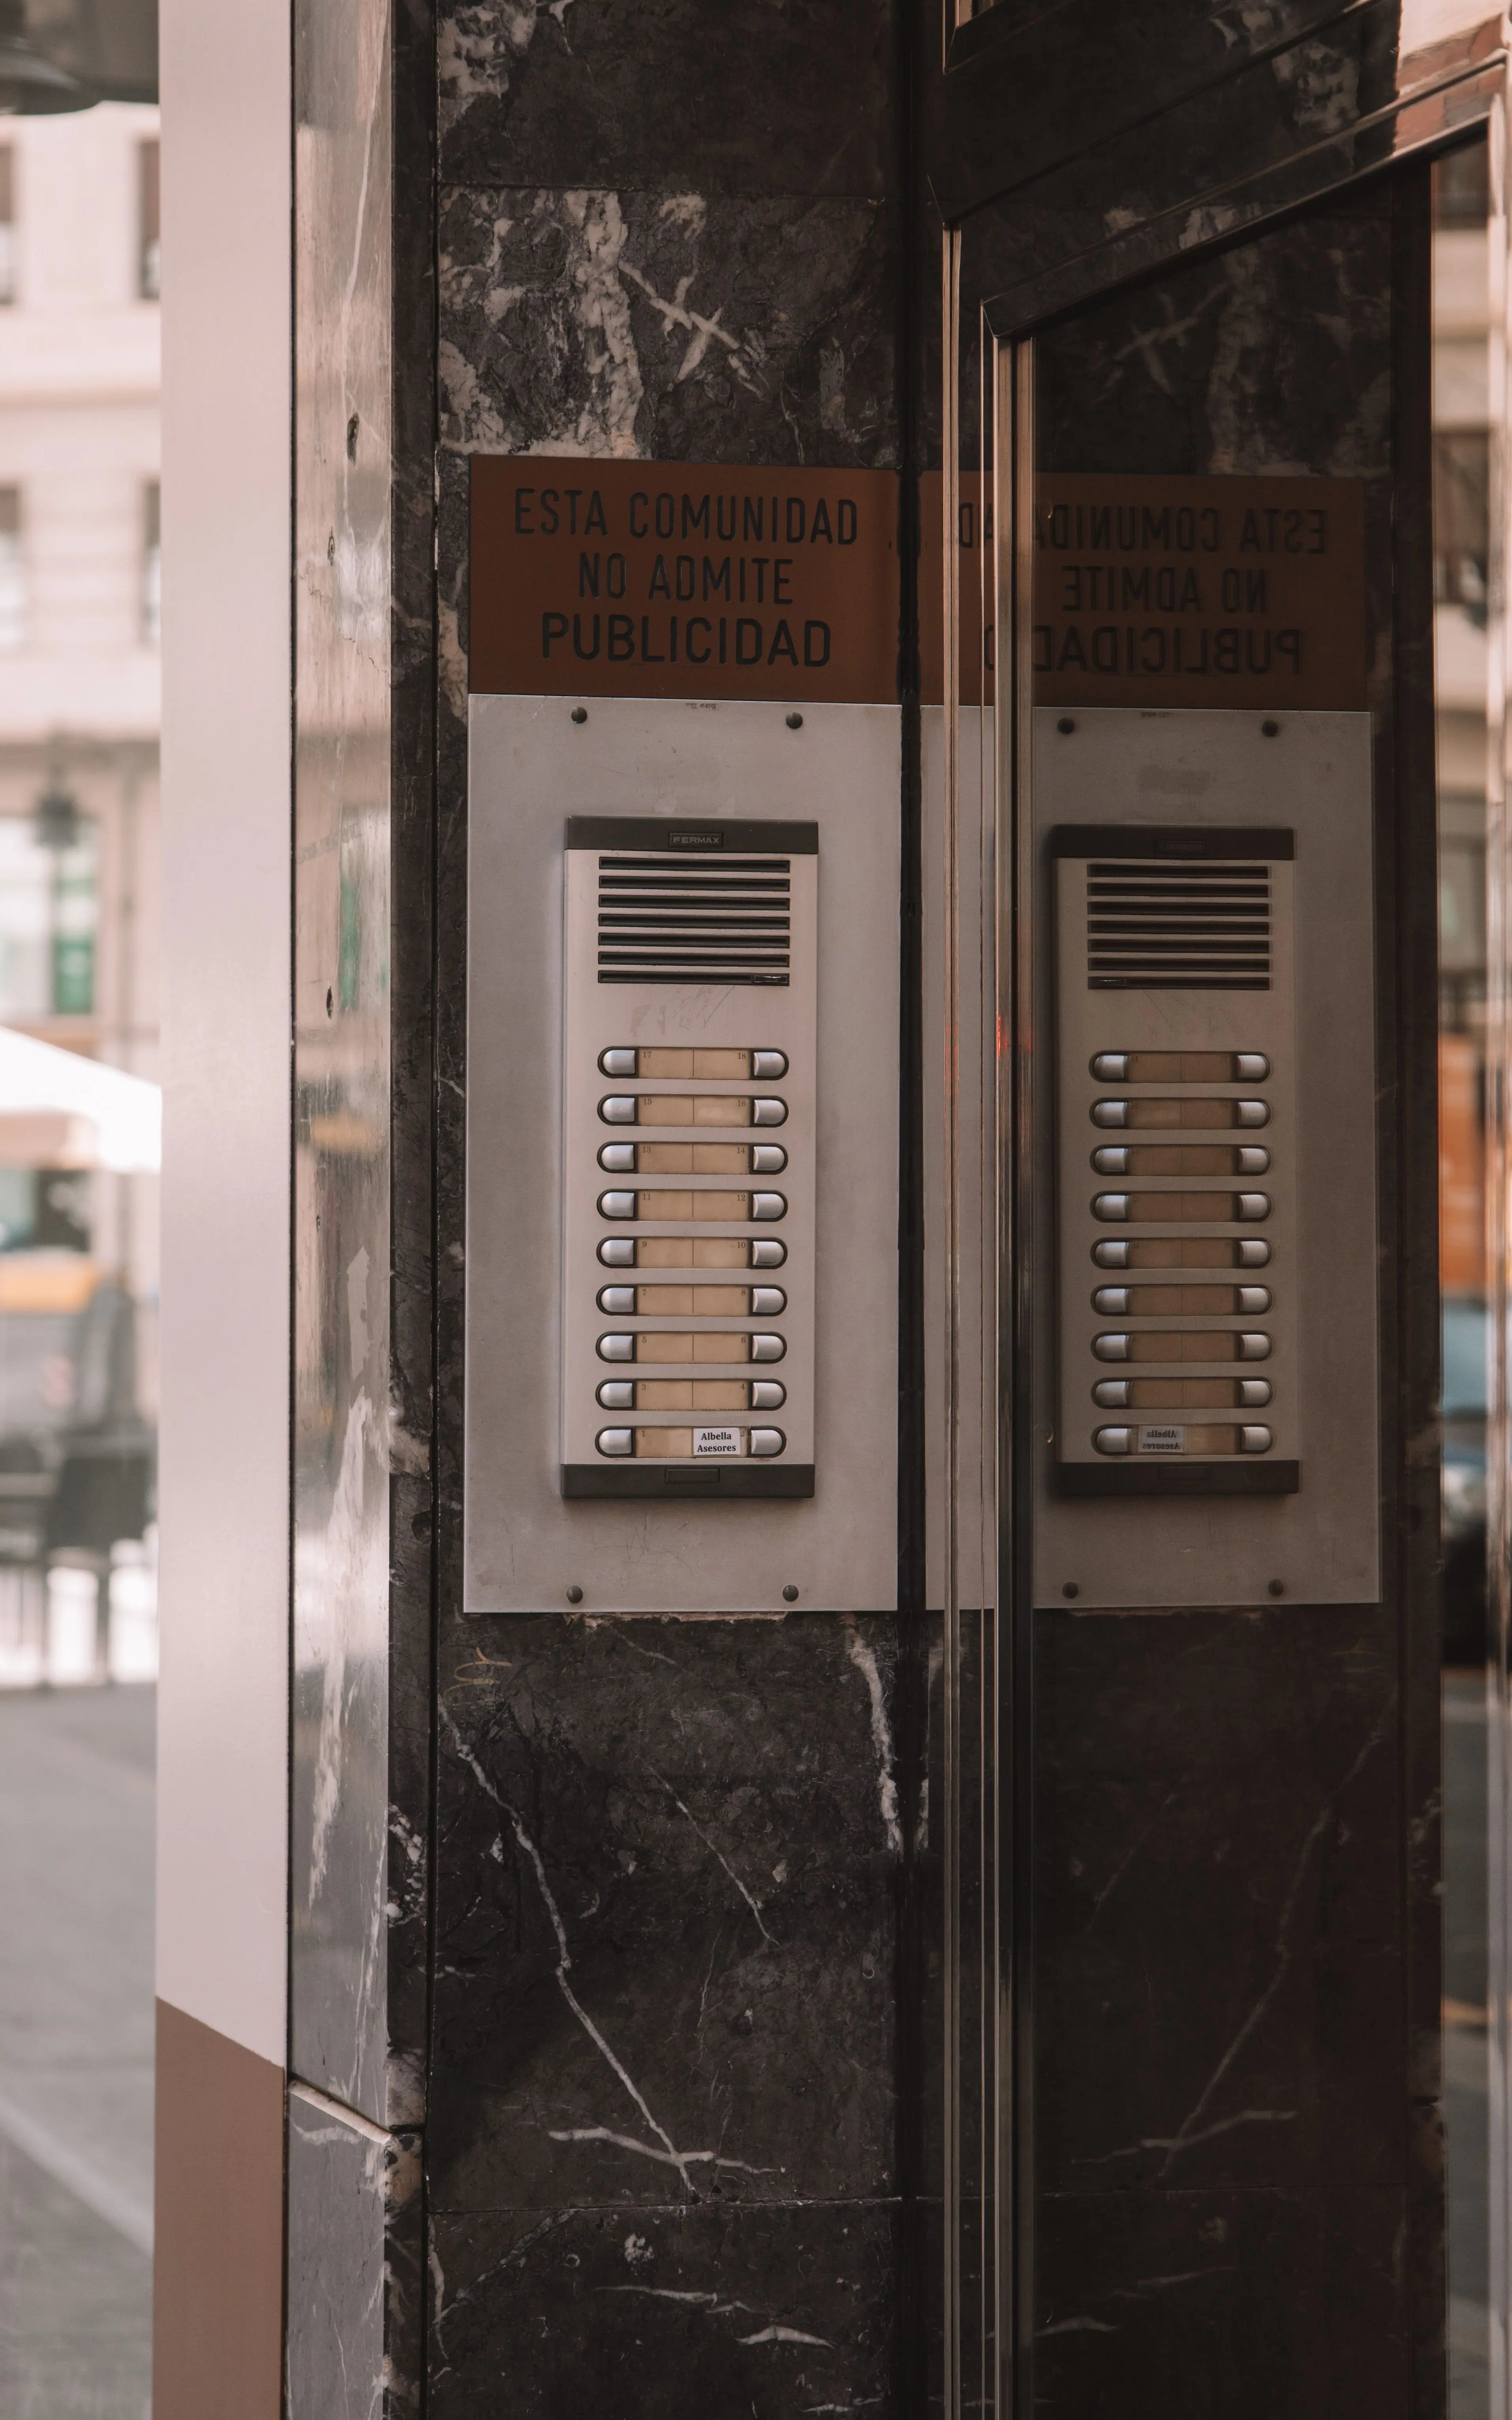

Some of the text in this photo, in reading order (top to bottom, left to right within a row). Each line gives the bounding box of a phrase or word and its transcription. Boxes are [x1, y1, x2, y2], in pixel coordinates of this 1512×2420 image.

[515, 487, 858, 545] ESTA COMUNIDAD
[579, 552, 793, 605] NO ADMITE
[541, 612, 831, 668] PUBLICIDAD
[701, 1432, 732, 1440] Albella
